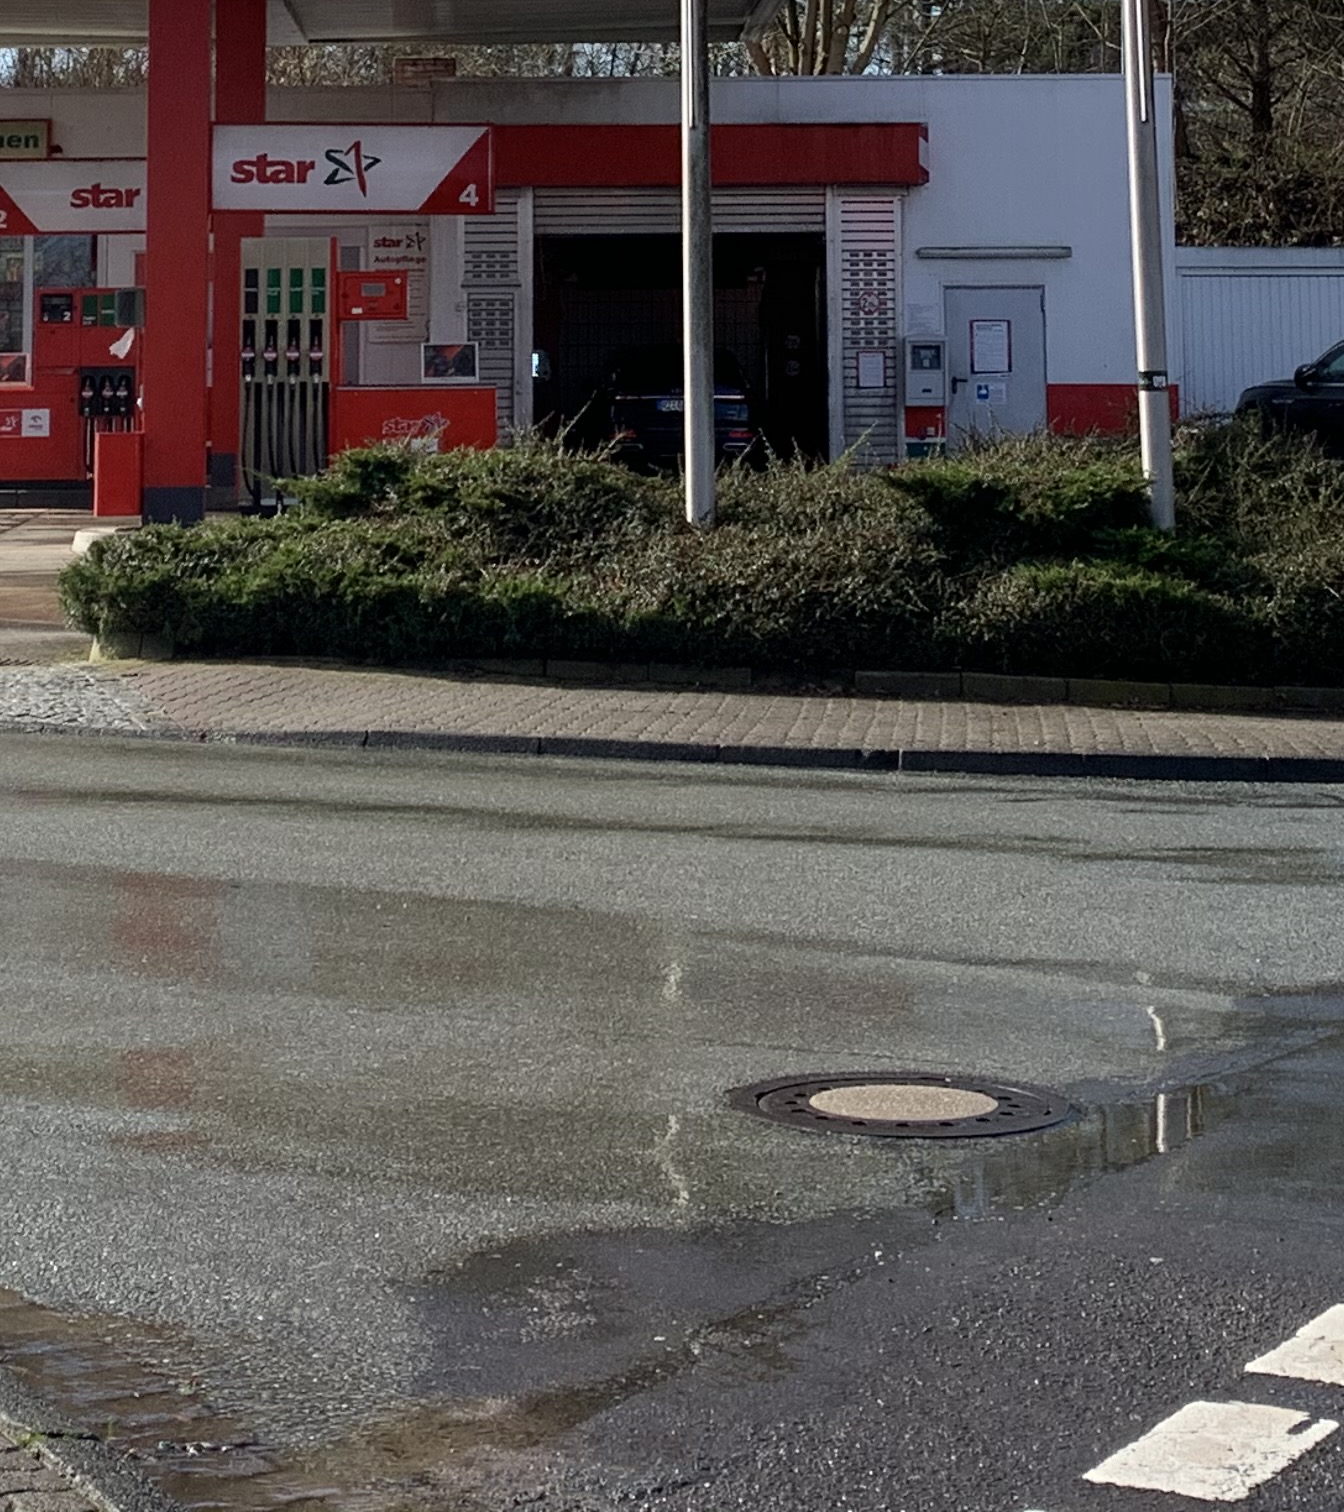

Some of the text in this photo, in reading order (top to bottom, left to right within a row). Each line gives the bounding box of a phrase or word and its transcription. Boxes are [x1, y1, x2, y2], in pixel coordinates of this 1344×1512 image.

[230, 153, 316, 185] star
[69, 182, 141, 209] star
[458, 184, 479, 207] 4
[373, 236, 403, 248] star
[373, 255, 427, 265] Autopflege
[63, 311, 71, 321] 2
